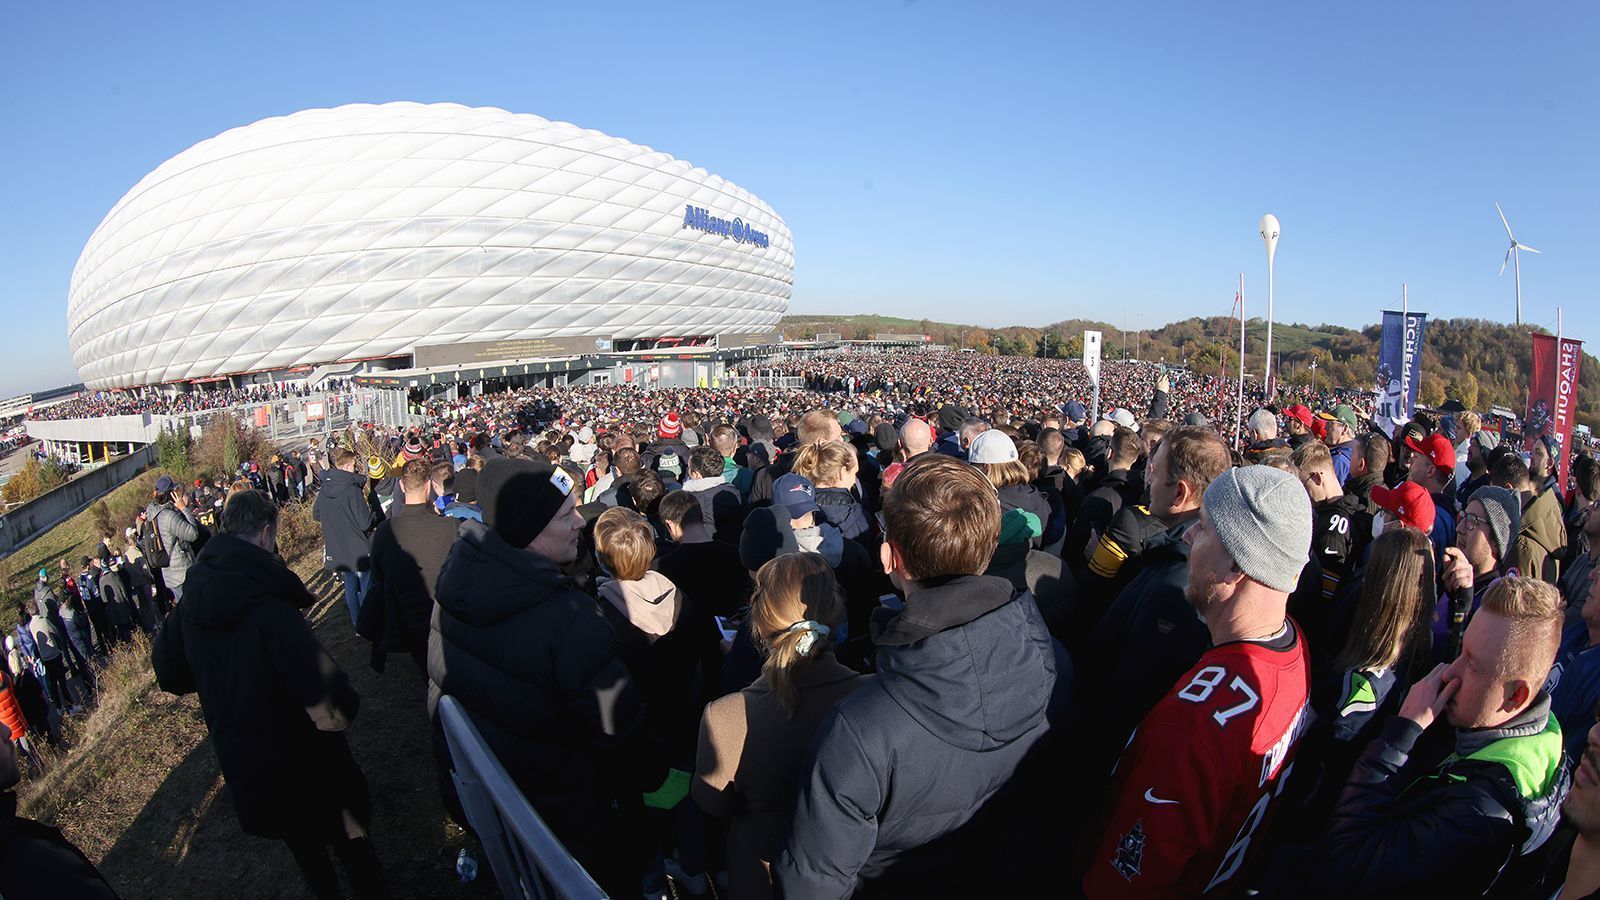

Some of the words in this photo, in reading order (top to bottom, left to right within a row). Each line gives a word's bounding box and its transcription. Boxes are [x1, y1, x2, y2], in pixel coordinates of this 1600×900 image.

[683, 204, 731, 238] Allianz
[744, 223, 769, 248] Arena
[200, 513, 215, 526] 64
[1328, 514, 1349, 535] 90
[1178, 665, 1261, 727] 87
